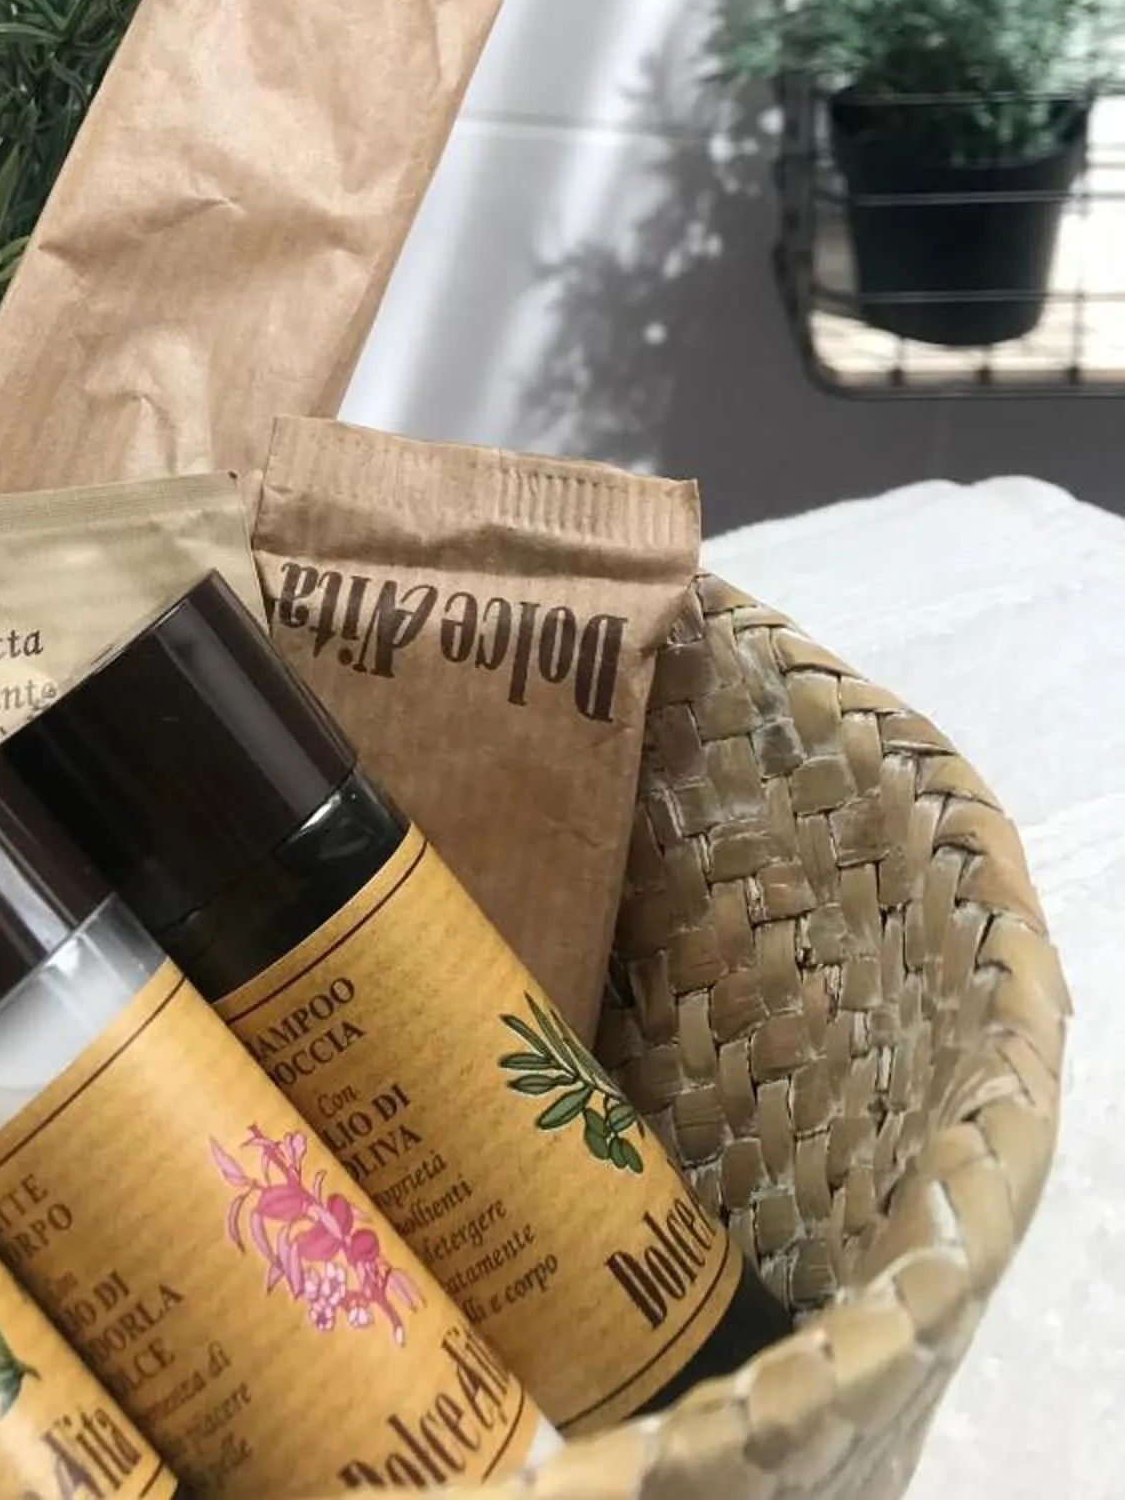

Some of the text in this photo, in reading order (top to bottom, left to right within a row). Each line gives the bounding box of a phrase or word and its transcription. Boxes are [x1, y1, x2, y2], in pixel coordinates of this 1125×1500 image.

[255, 977, 355, 1058] AMPOO
[274, 1020, 365, 1086] OCCIA
[318, 1085, 357, 1118] Con
[324, 1083, 410, 1151] LIO DI
[93, 1270, 130, 1312] DI
[447, 1223, 535, 1296] atamente
[505, 1253, 558, 1305] corpo
[89, 1283, 184, 1362] DORLA
